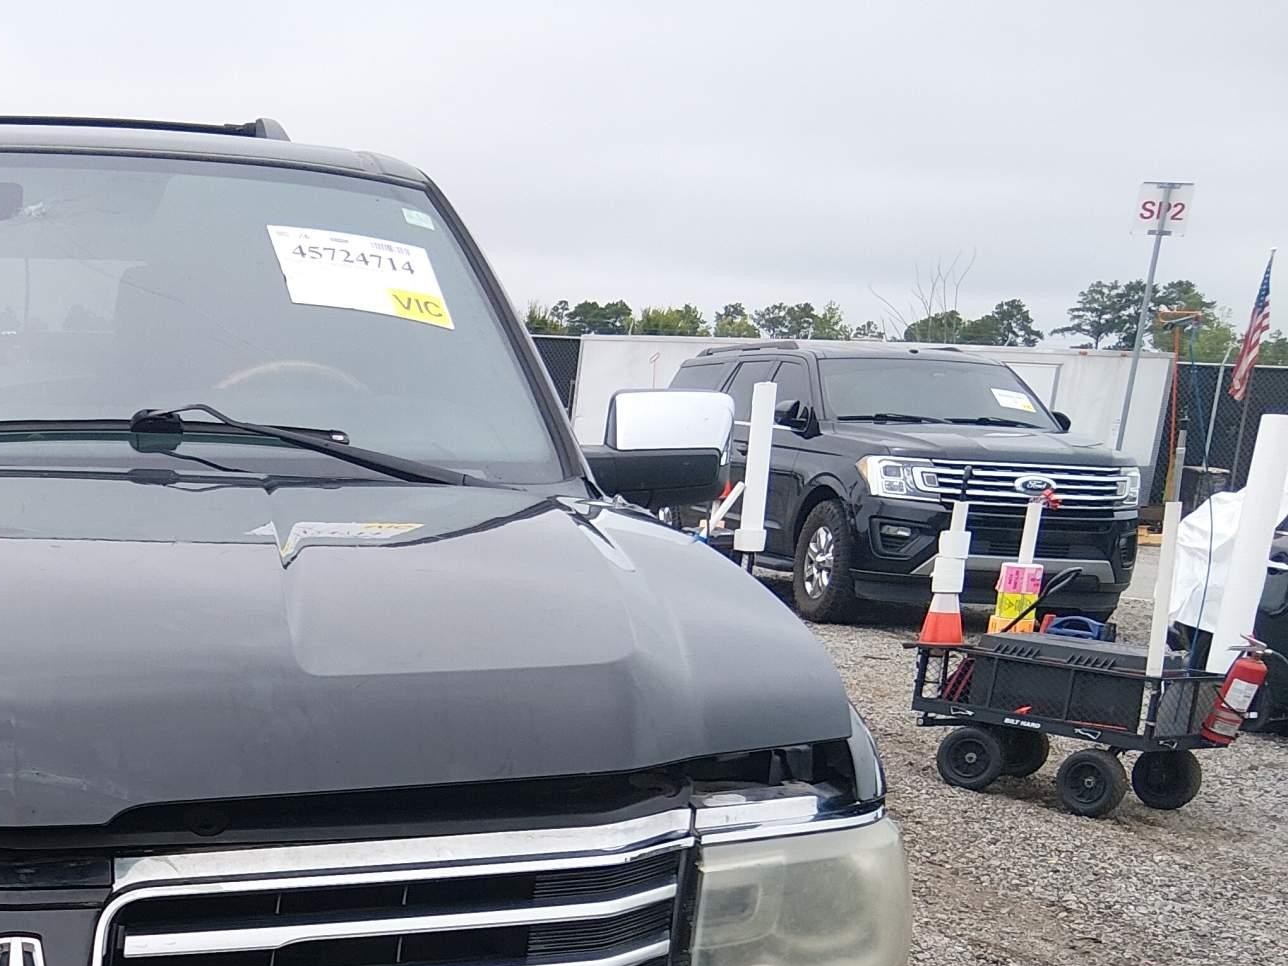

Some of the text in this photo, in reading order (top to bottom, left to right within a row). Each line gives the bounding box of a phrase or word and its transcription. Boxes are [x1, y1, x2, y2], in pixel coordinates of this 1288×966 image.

[1139, 200, 1185, 221] SP2
[292, 244, 415, 275] 45724714
[393, 293, 443, 318] VIC
